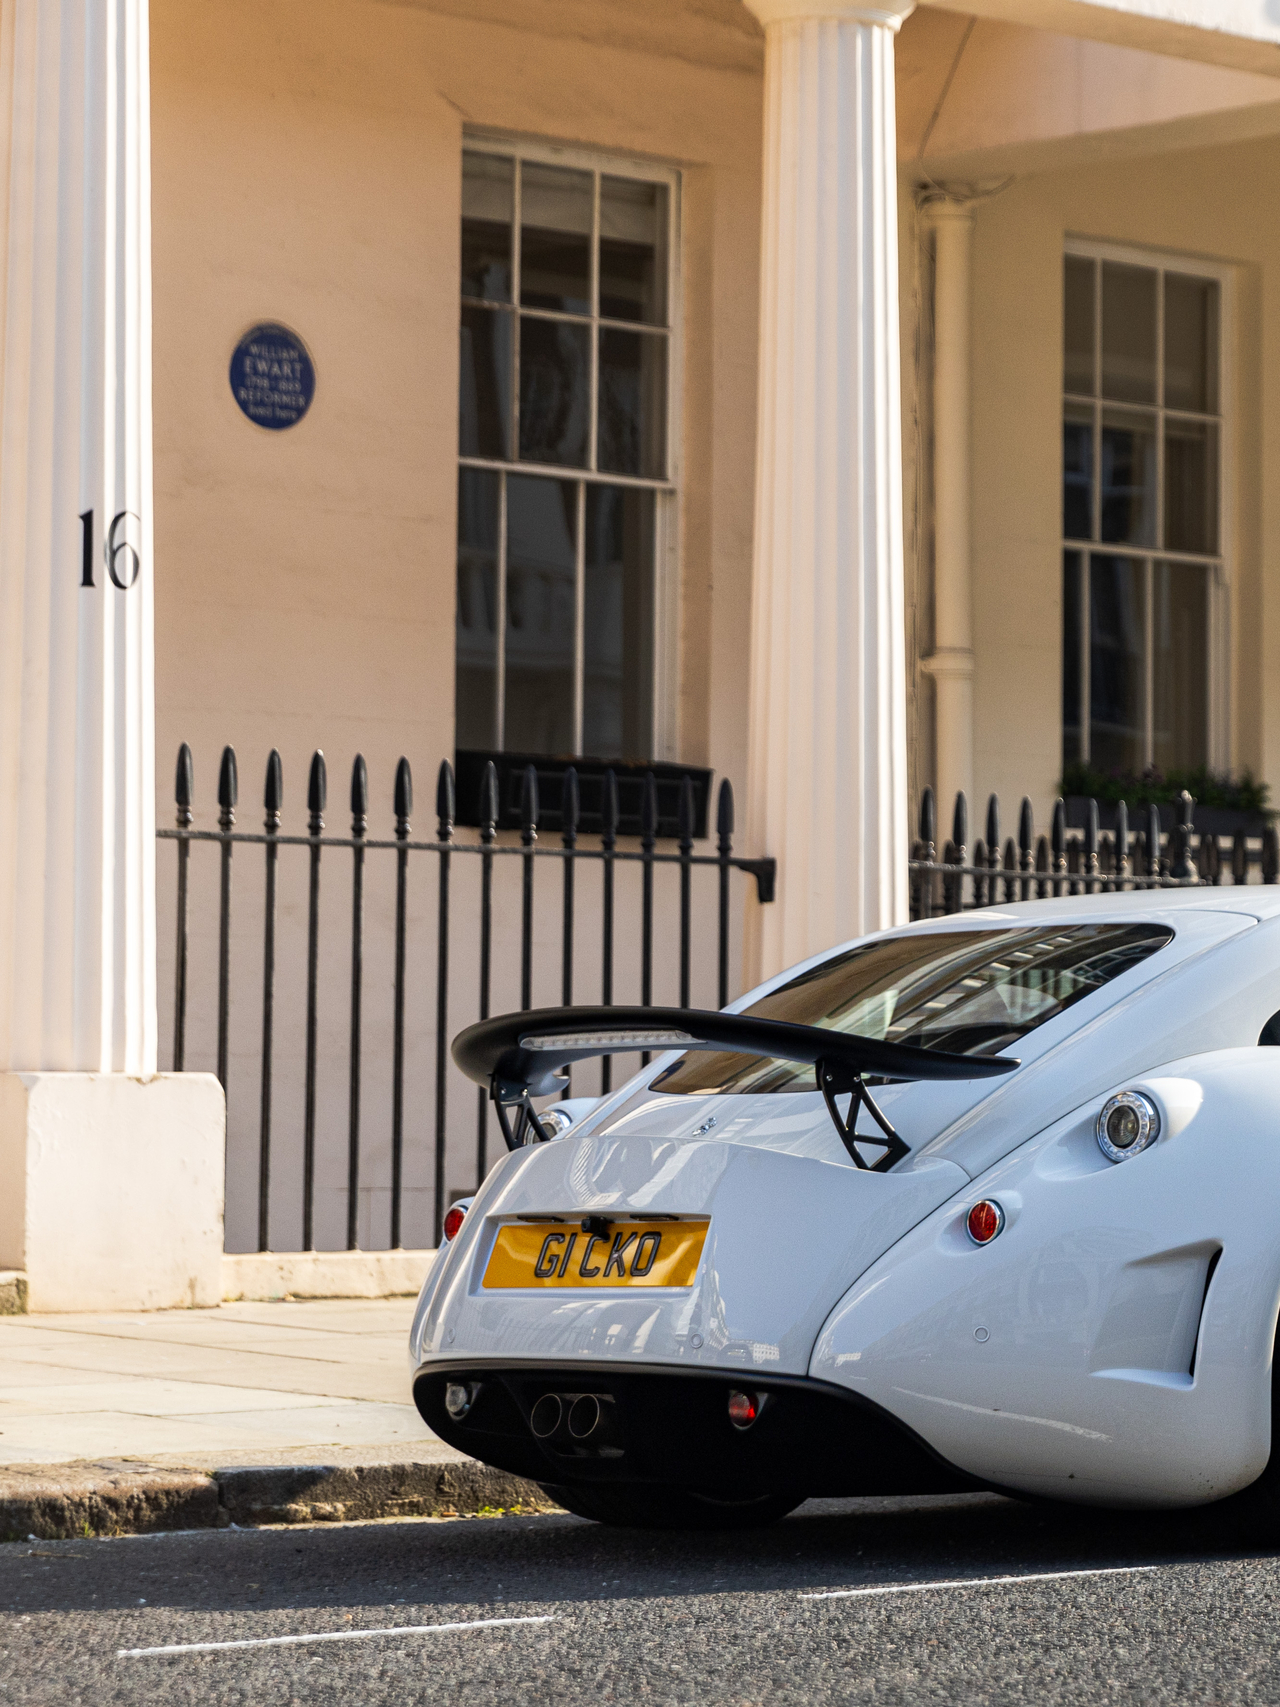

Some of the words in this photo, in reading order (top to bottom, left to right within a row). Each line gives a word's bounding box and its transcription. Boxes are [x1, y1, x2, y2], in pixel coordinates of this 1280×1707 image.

[249, 344, 299, 361] WILLIAM
[244, 356, 303, 381] EWART
[238, 387, 306, 409] REFORMER
[78, 507, 141, 591] 16
